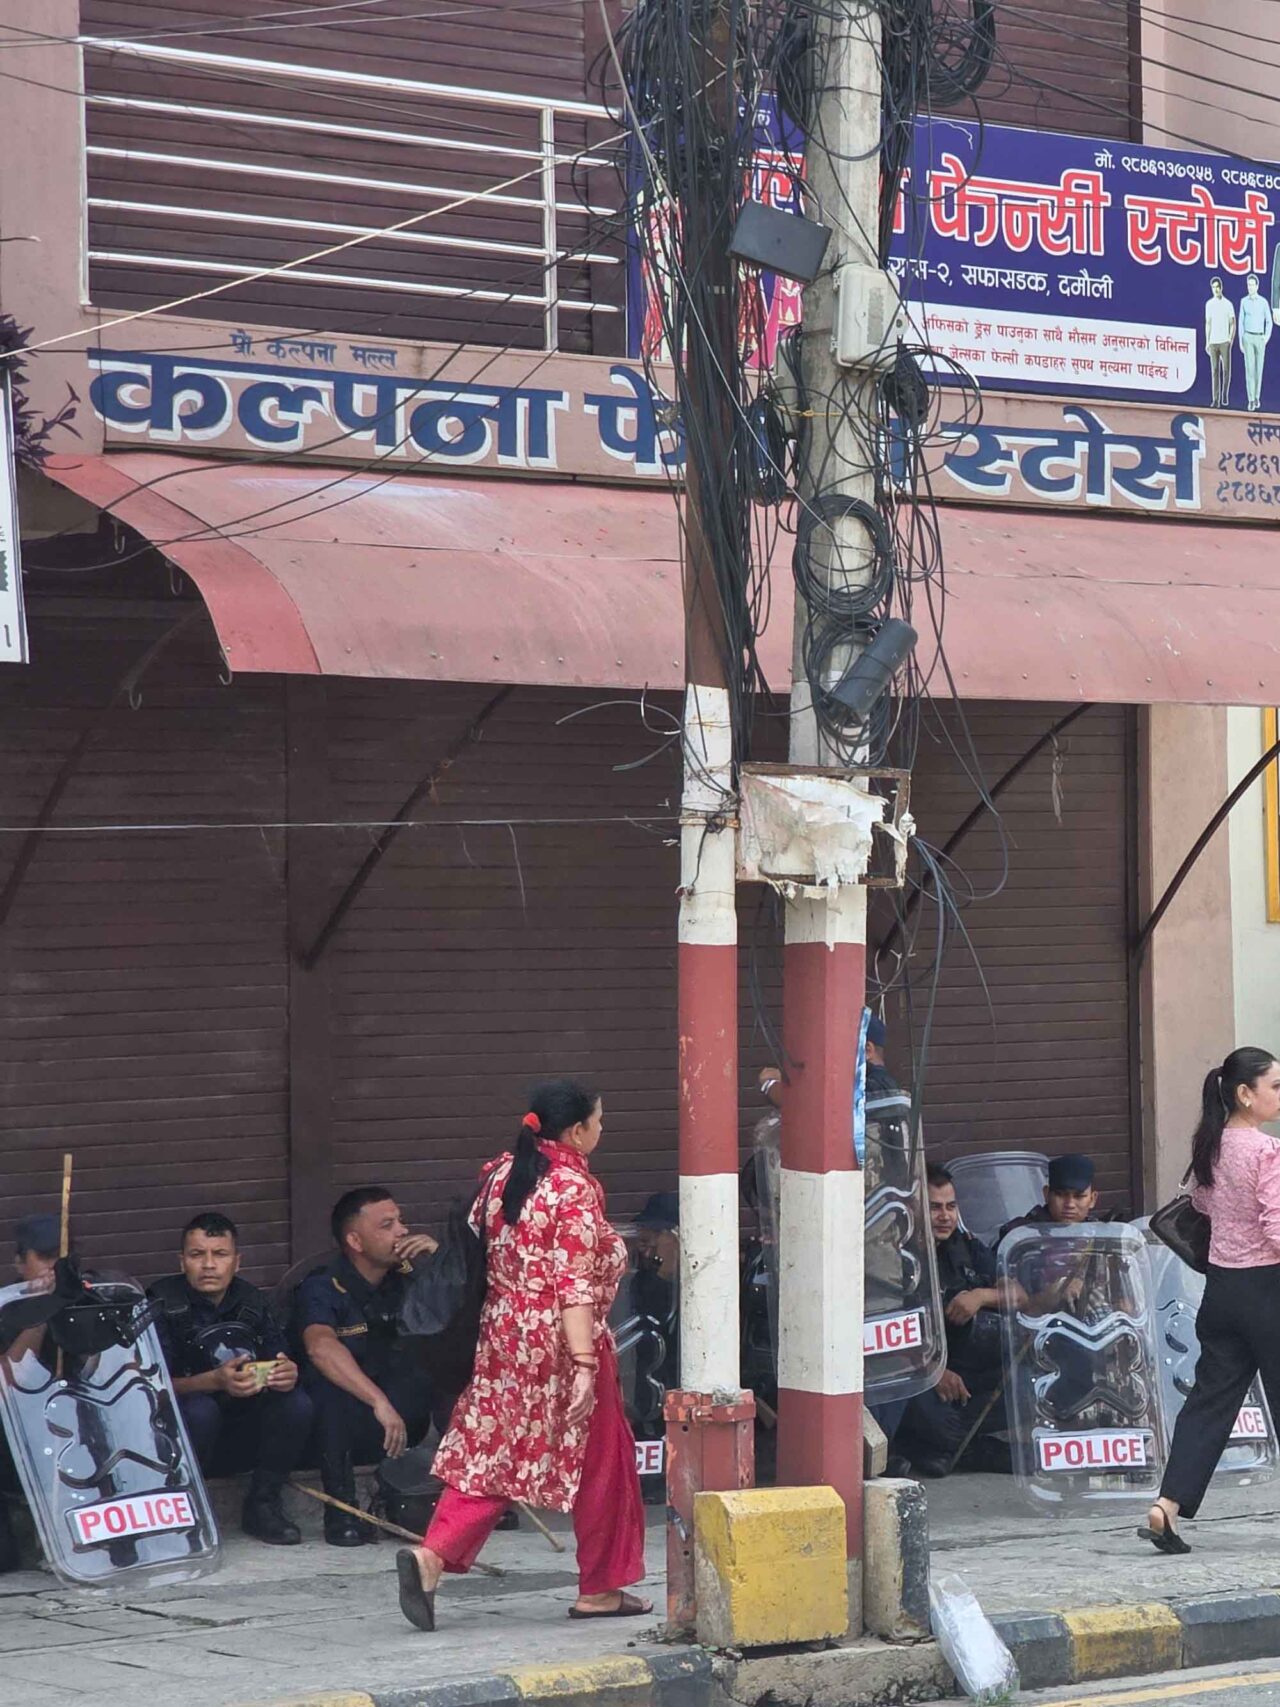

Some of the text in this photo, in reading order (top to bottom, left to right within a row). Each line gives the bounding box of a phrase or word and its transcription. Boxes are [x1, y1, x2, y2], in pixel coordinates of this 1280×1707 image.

[1094, 149, 1116, 170] मो.
[926, 151, 1112, 256] फेन्सी
[1124, 184, 1275, 275] स्टोर्स
[1057, 268, 1114, 300] दमौली
[349, 344, 398, 371] मल्ल
[87, 346, 570, 470] कल्पना
[939, 405, 1206, 510] स्टोर्स
[863, 1316, 918, 1352] ICE
[1232, 1411, 1264, 1434] ICE
[1044, 1438, 1142, 1467] POLICE
[79, 1497, 191, 1539] POLICE
